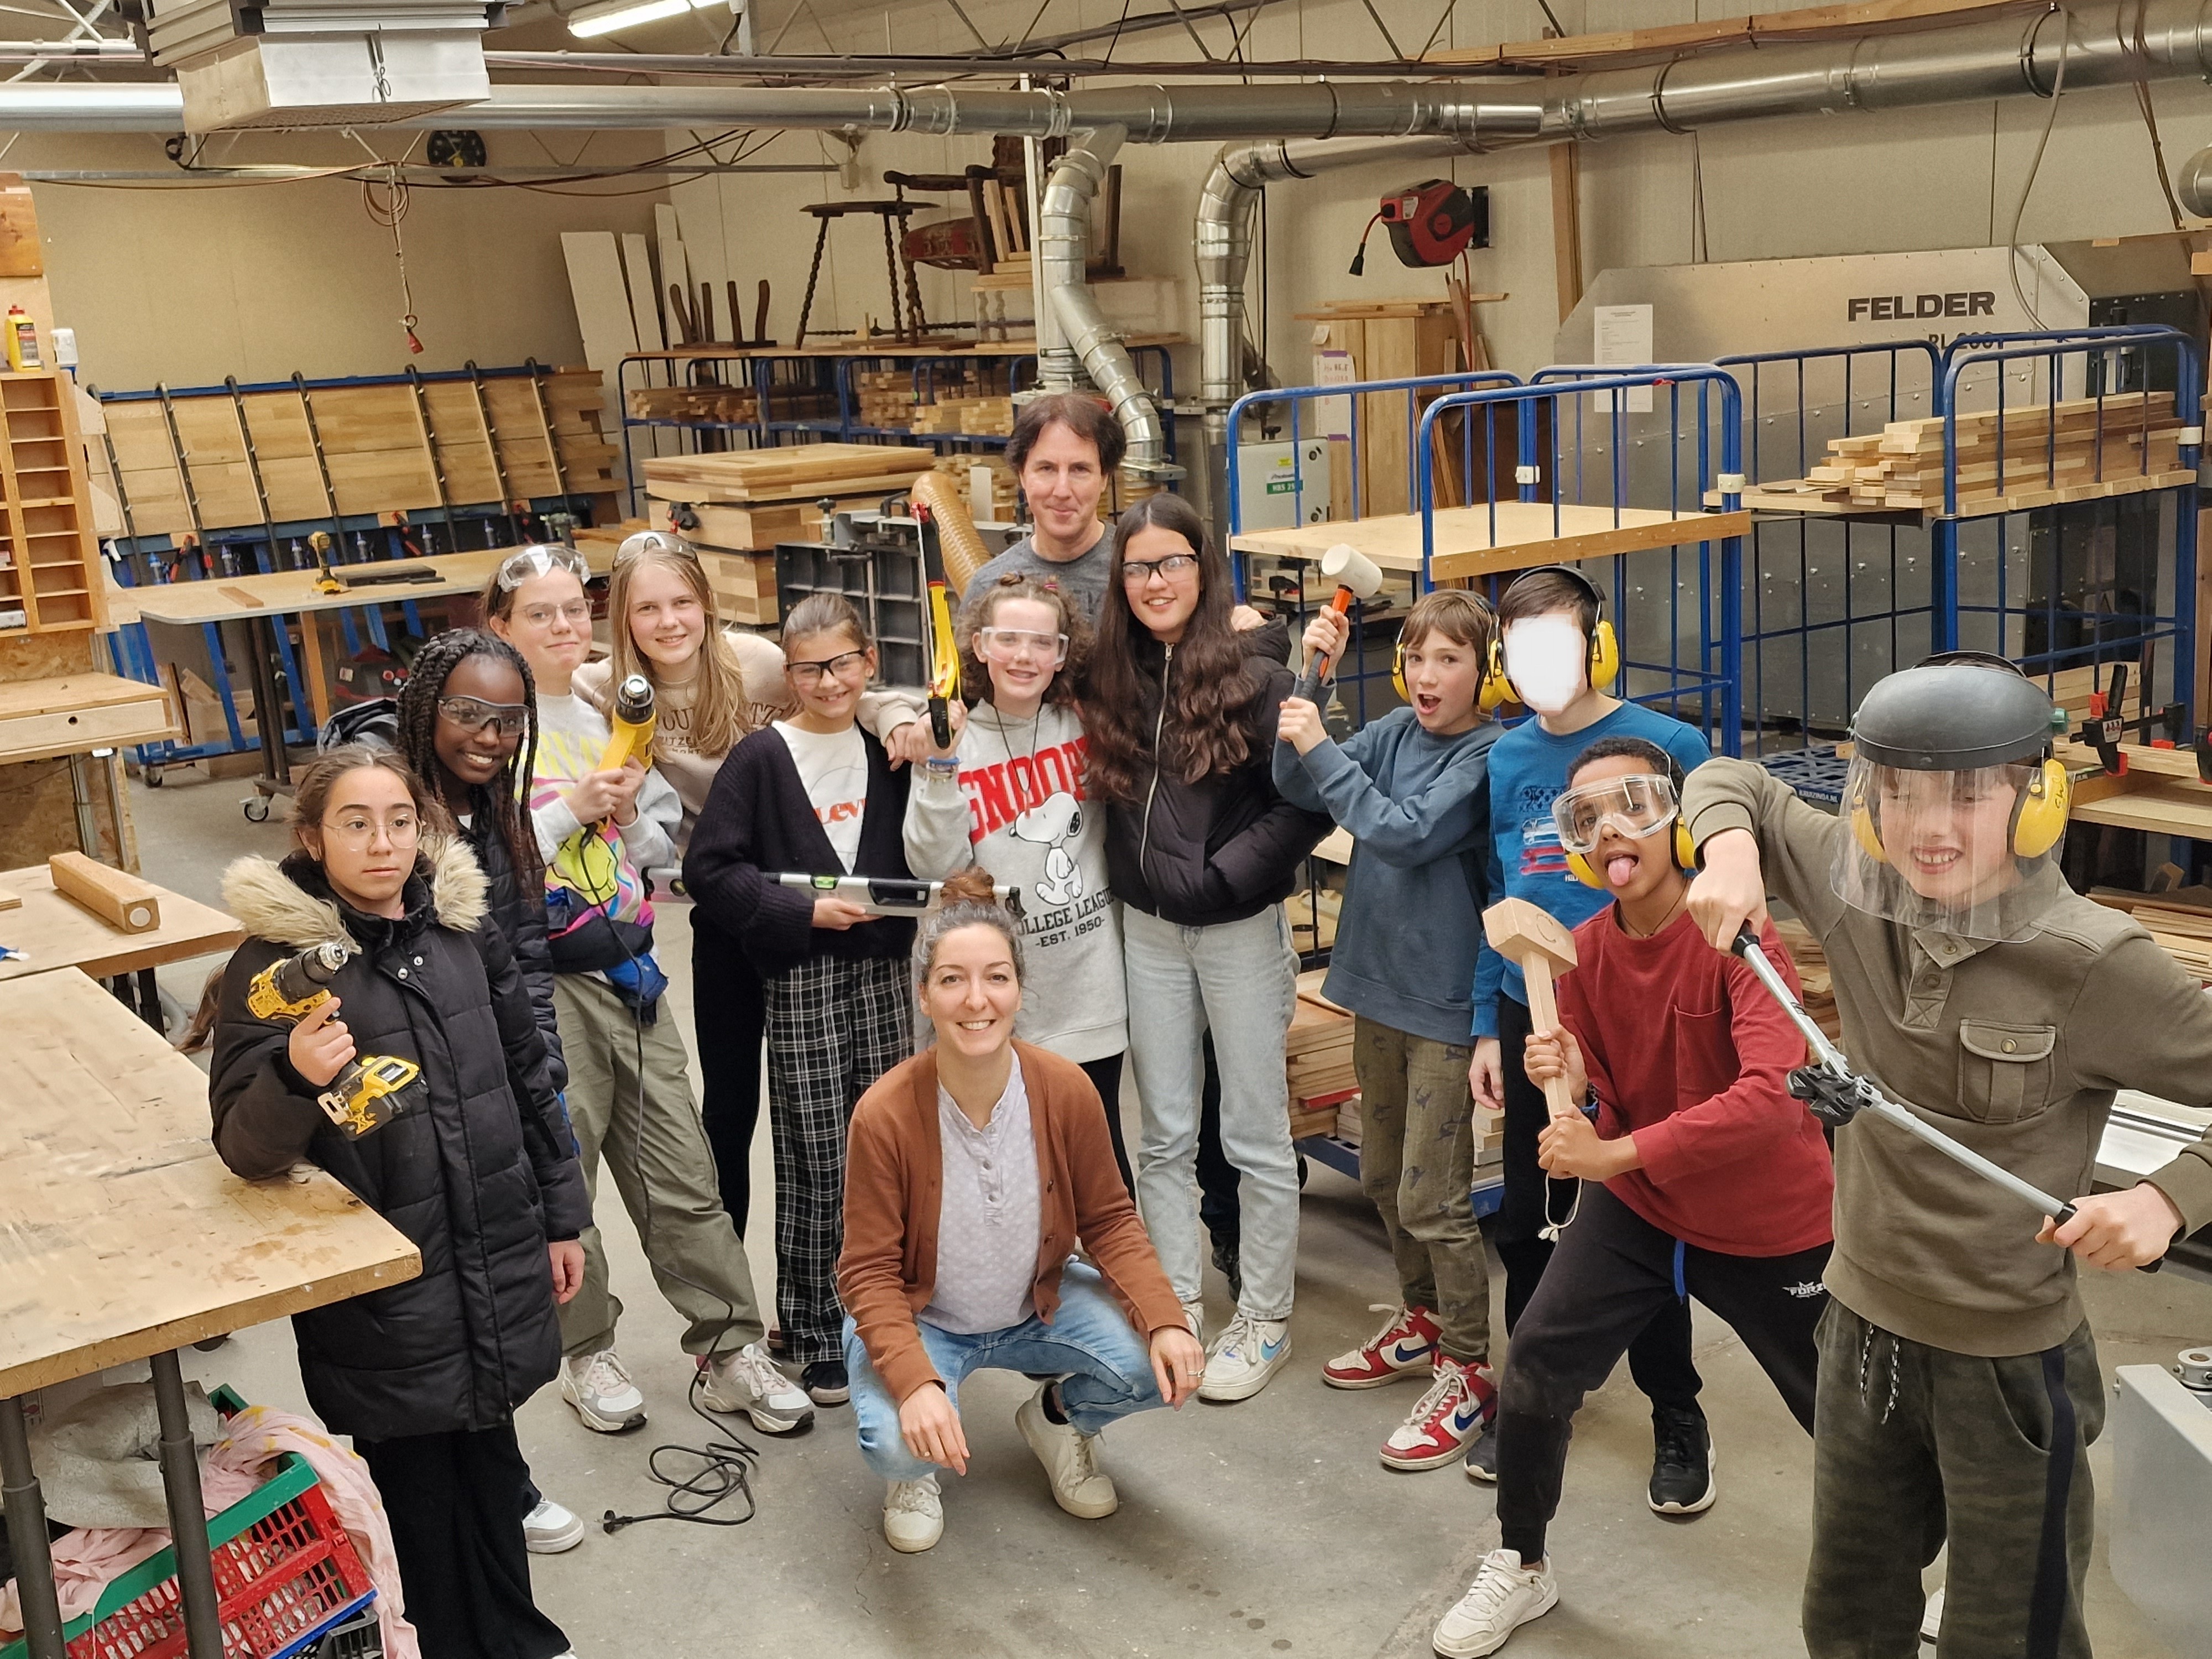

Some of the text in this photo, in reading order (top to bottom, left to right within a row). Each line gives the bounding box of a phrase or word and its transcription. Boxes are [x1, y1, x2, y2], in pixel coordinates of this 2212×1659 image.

[1848, 291, 1995, 321] FELDER
[958, 736, 1088, 845] SNOOP
[1017, 888, 1114, 935] OLLEGE LEAGU
[1074, 916, 1105, 937] 1950-
